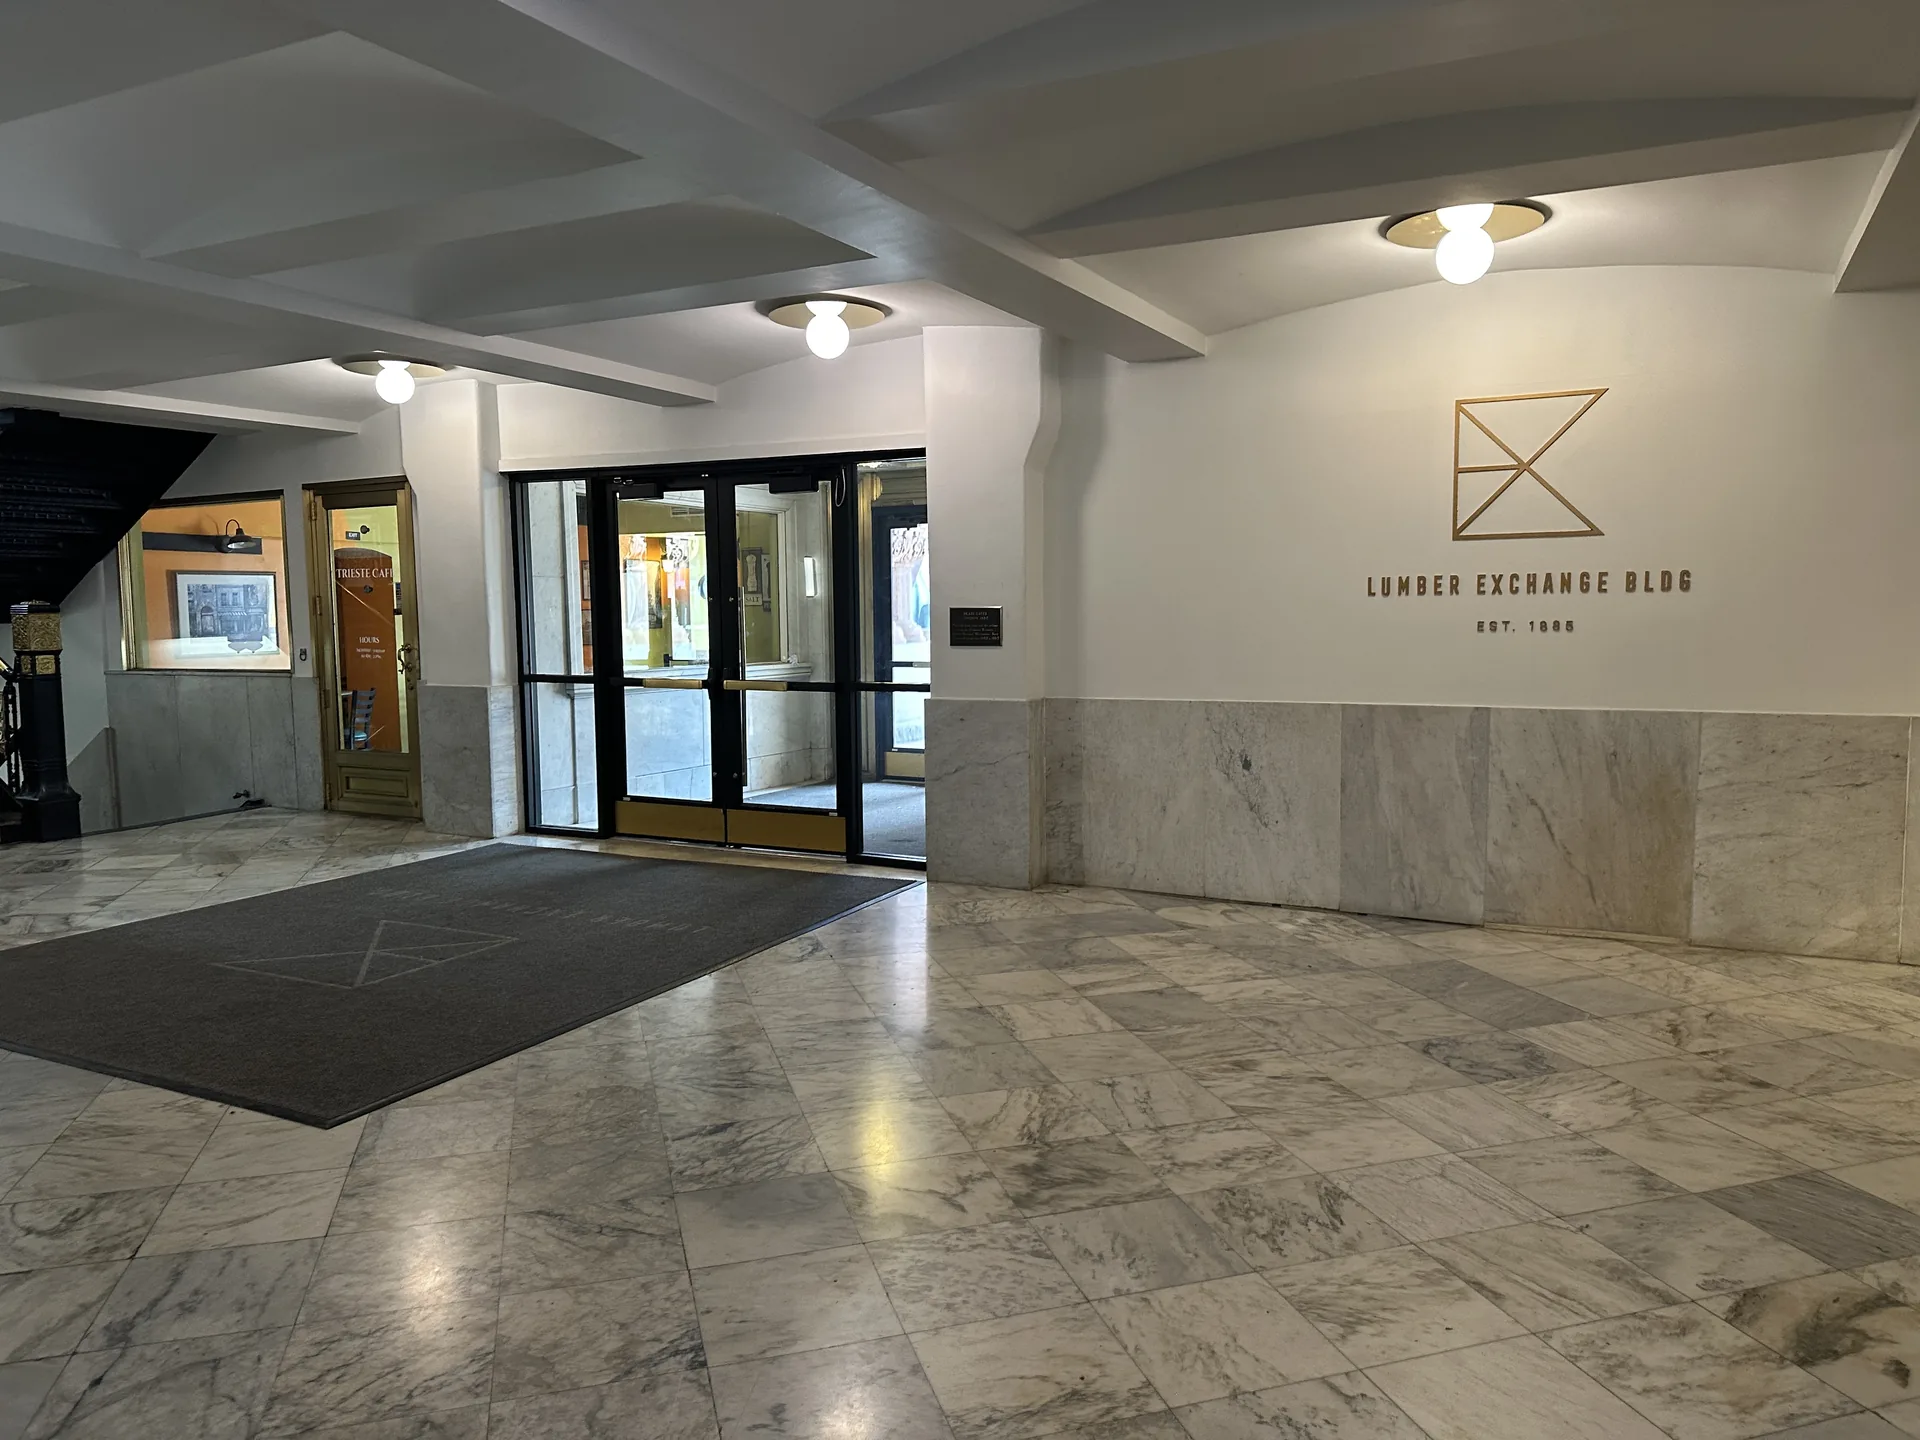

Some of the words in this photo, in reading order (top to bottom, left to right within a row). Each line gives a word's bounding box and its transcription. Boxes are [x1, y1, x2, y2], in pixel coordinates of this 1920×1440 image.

[336, 568, 371, 578] TRIESTE
[1367, 575, 1460, 597] LUMBER
[1476, 572, 1609, 595] EXCHANGE
[1625, 570, 1692, 593] BLDG
[1476, 620, 1516, 633] EST.
[1529, 620, 1574, 633] 1885
[359, 636, 380, 644] HOURS
